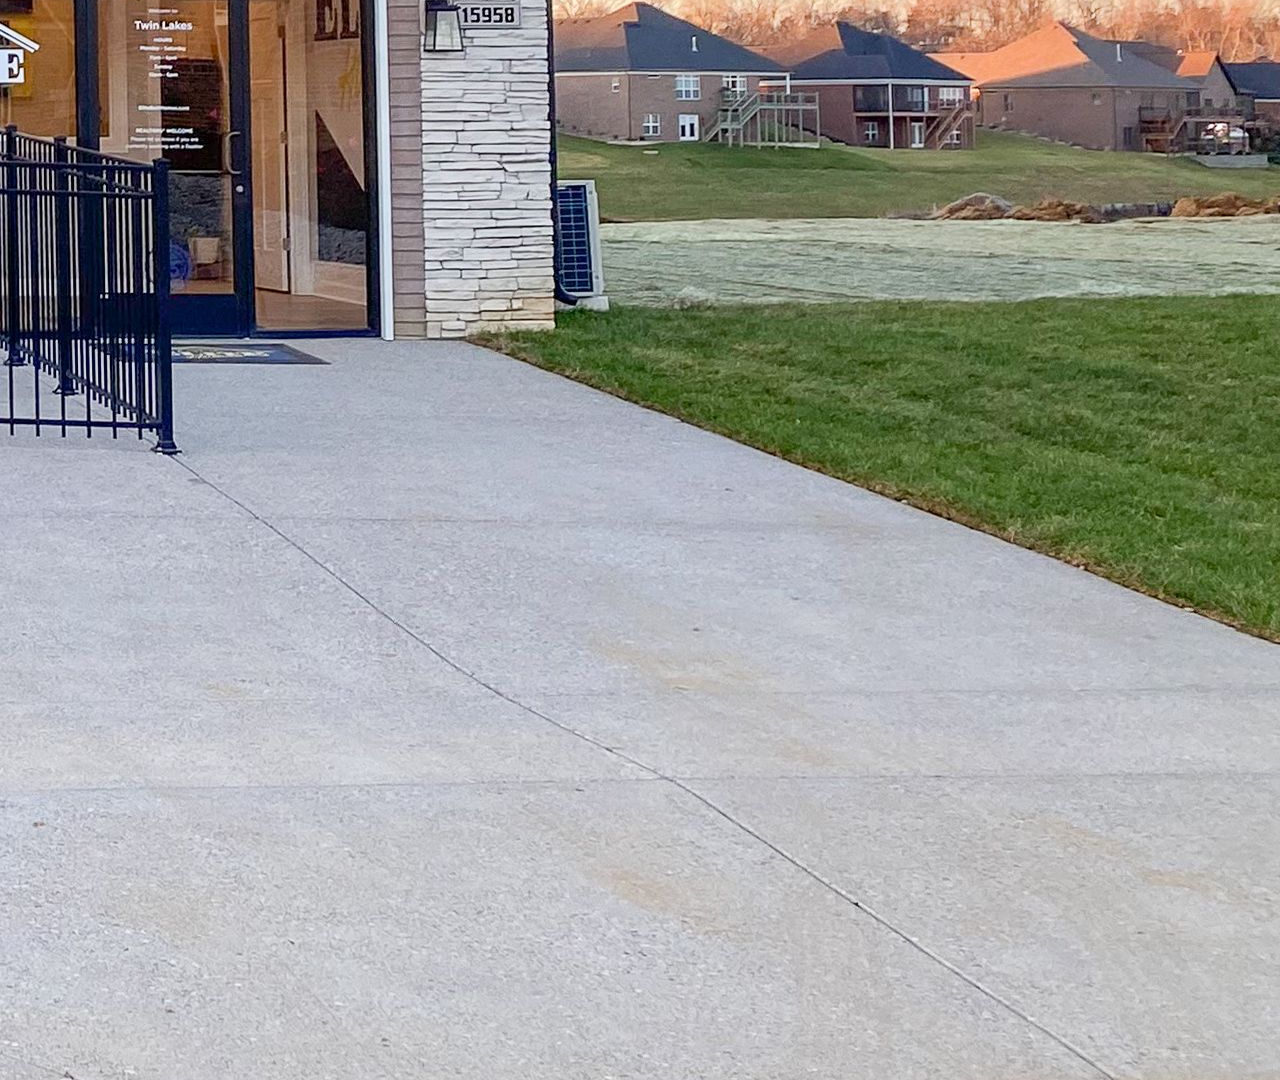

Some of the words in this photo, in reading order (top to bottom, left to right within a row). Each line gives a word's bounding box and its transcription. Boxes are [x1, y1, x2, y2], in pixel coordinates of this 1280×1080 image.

[462, 7, 514, 23] 15958
[134, 20, 160, 30] Twin
[161, 20, 193, 30] Lakes
